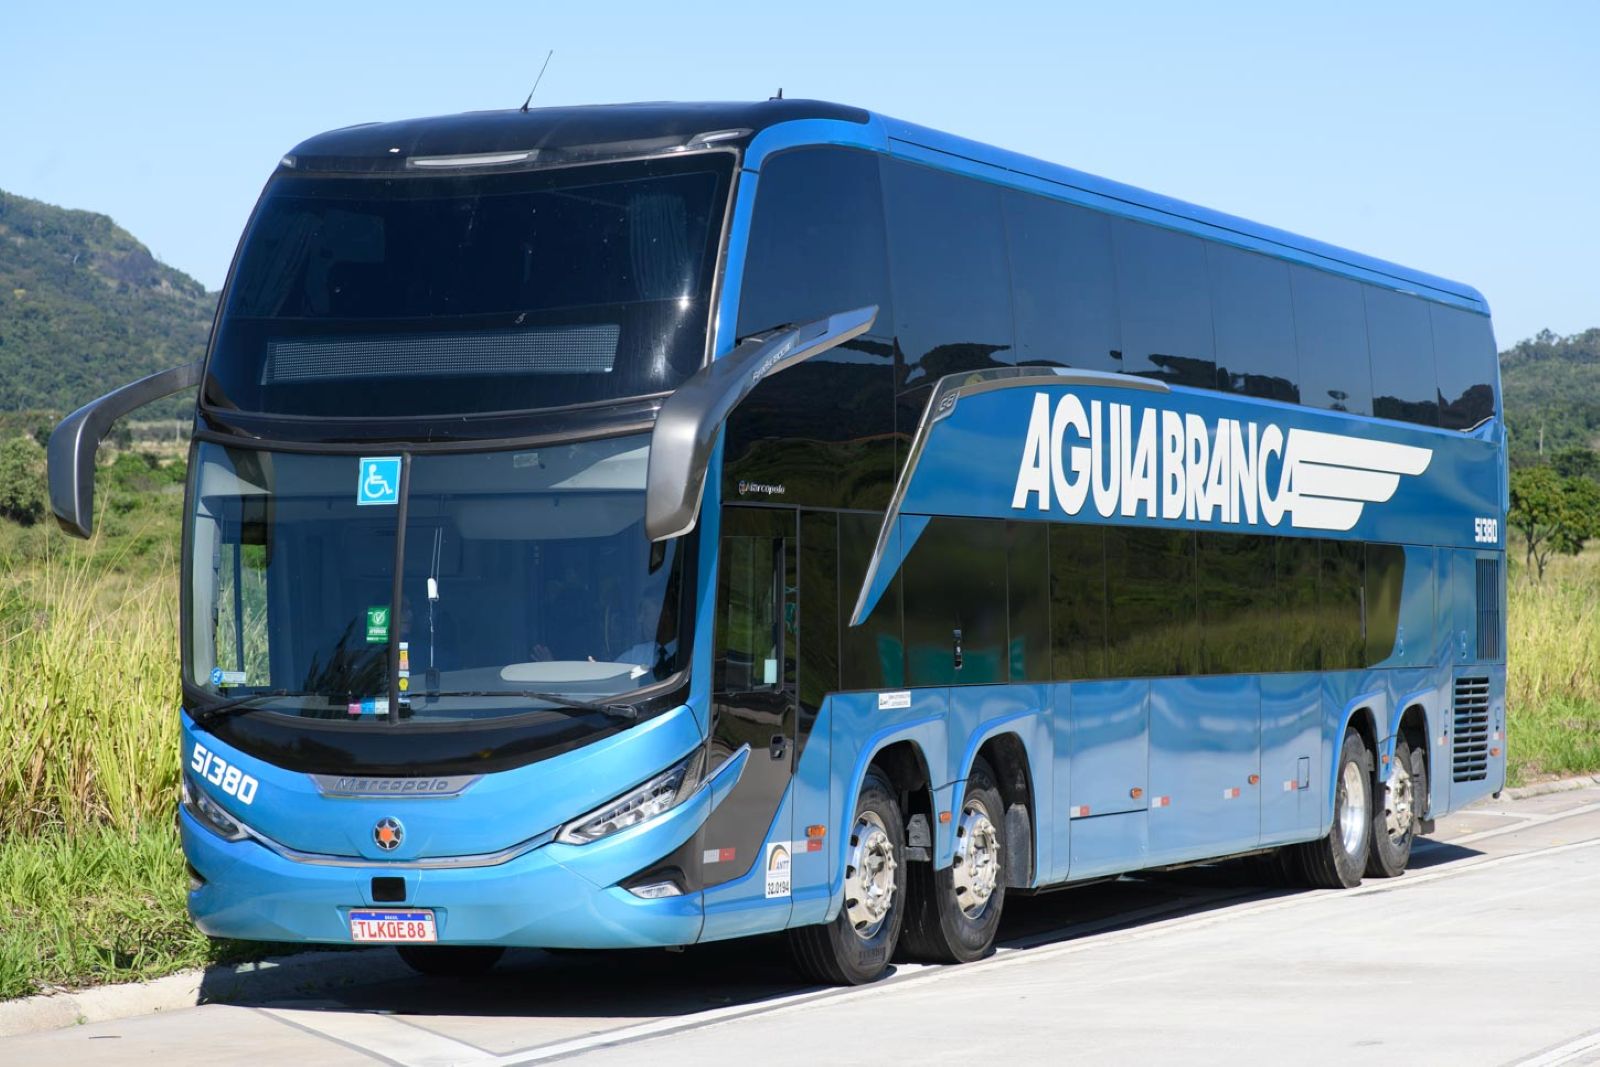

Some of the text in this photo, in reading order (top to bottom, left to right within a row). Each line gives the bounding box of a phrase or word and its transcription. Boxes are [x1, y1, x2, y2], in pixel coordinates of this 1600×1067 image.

[1011, 391, 1299, 527] AGUIA BRANCA
[1475, 517, 1498, 543] 51380
[191, 742, 259, 805] 51380
[335, 778, 448, 793] Marcopolo
